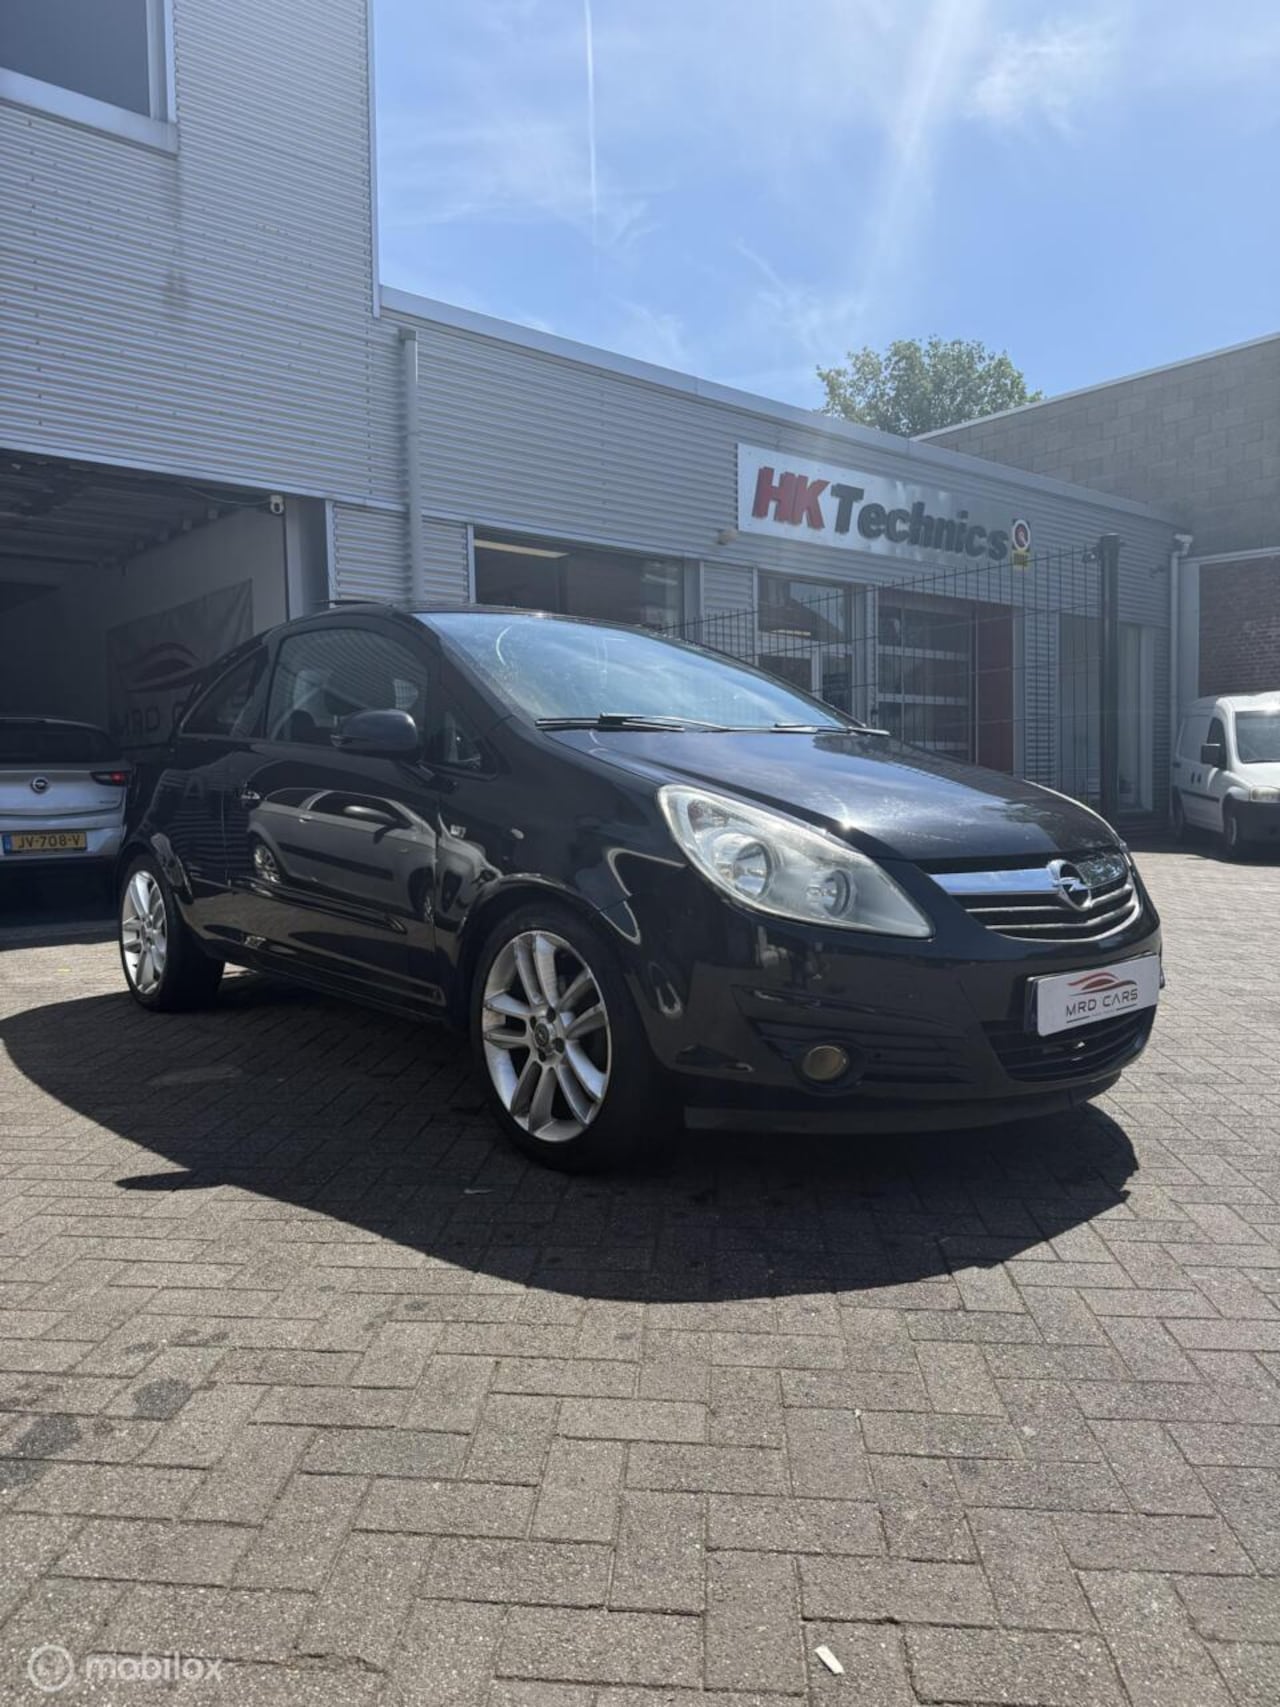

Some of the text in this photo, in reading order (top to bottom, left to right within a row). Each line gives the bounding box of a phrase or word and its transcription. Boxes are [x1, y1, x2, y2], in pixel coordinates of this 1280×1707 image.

[18, 834, 81, 849] JV-708-V
[1066, 999, 1097, 1017] MRD
[1102, 988, 1138, 1007] CARS
